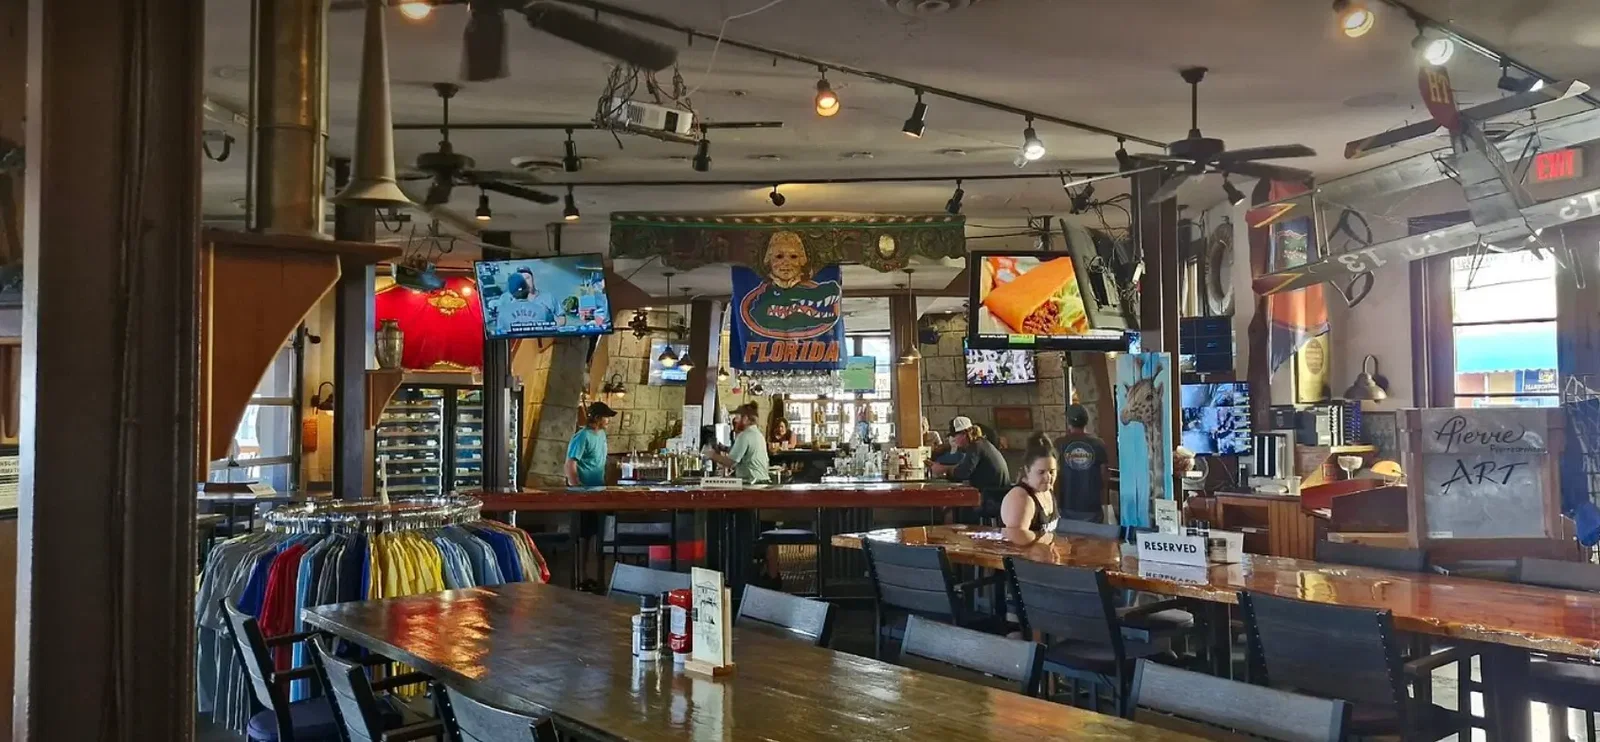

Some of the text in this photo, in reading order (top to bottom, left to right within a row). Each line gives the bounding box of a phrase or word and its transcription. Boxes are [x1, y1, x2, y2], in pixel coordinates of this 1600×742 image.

[1536, 150, 1575, 180] EXIT
[743, 340, 840, 363] FLORIDA
[1440, 459, 1529, 494] ART
[1144, 540, 1197, 554] RESERVED
